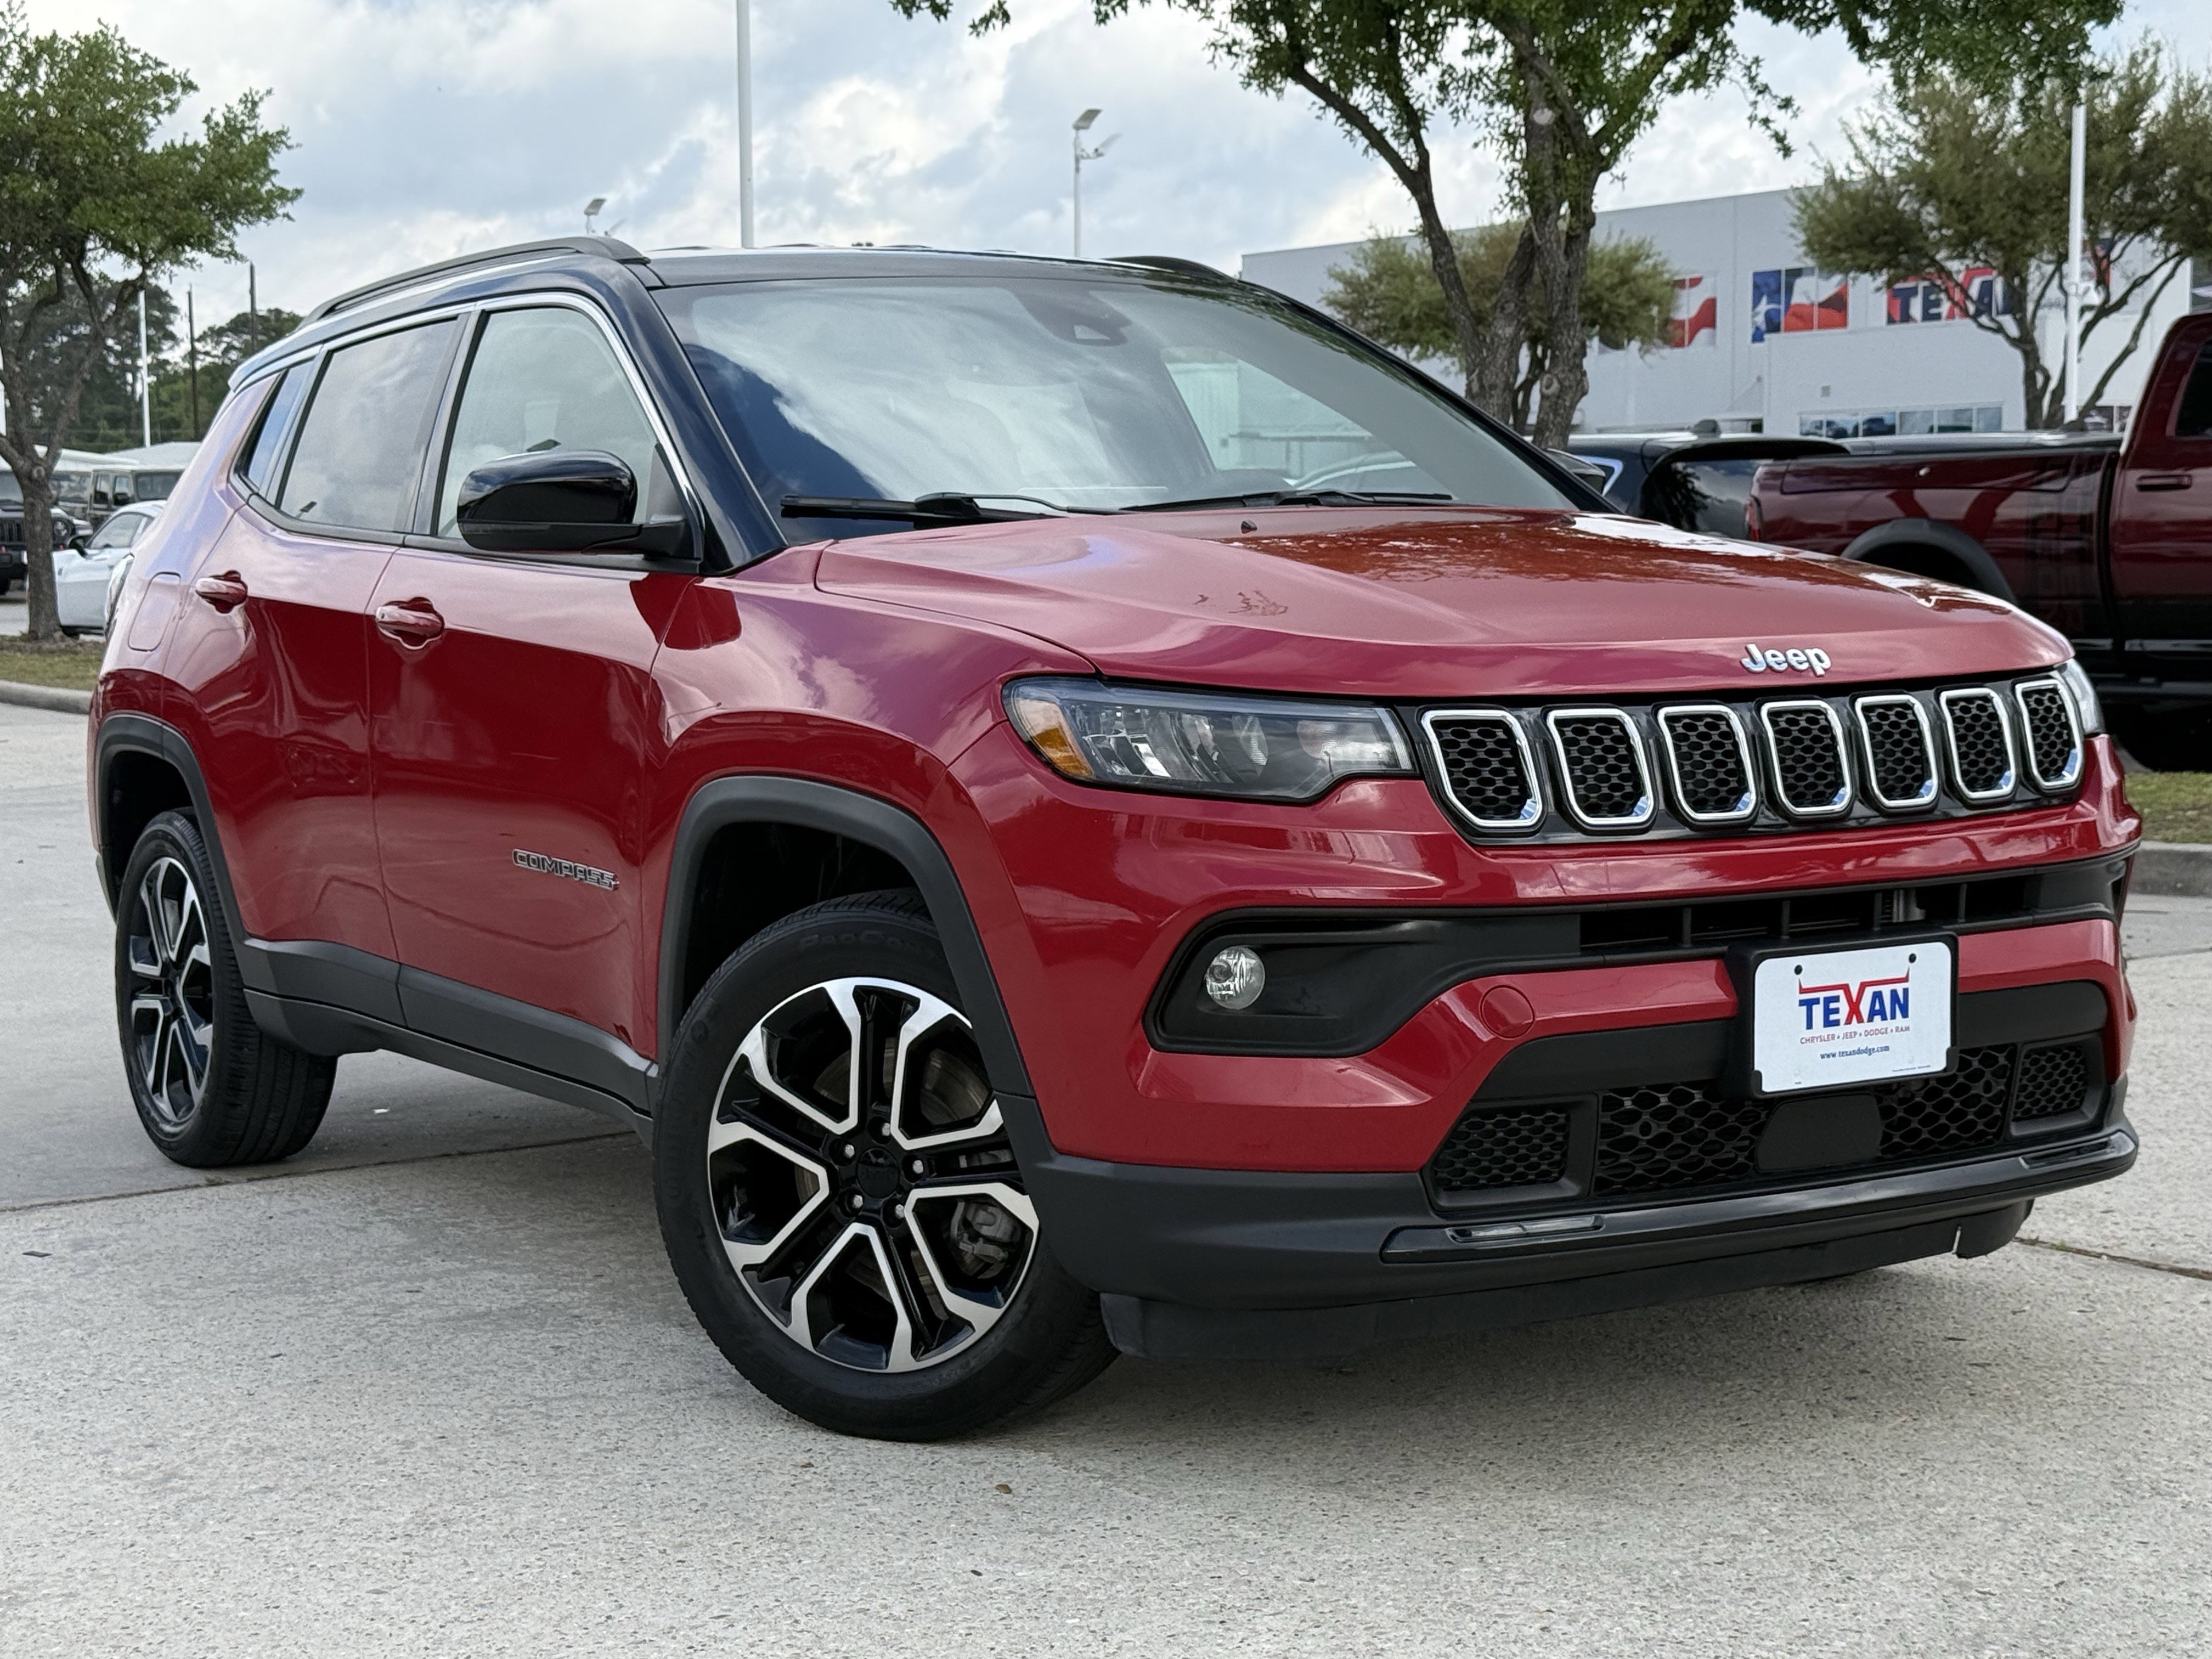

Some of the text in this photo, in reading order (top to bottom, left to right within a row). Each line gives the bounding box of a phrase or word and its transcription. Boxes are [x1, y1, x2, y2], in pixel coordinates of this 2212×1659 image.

[1740, 644, 1831, 678] Jeep
[512, 849, 619, 891] COMPASS
[1798, 978, 1910, 1030] TEXAN
[1800, 1025, 1911, 1045] CHRYSLER JEEP DODGE RAM
[1820, 1045, 1890, 1059] www.texandodge.com
